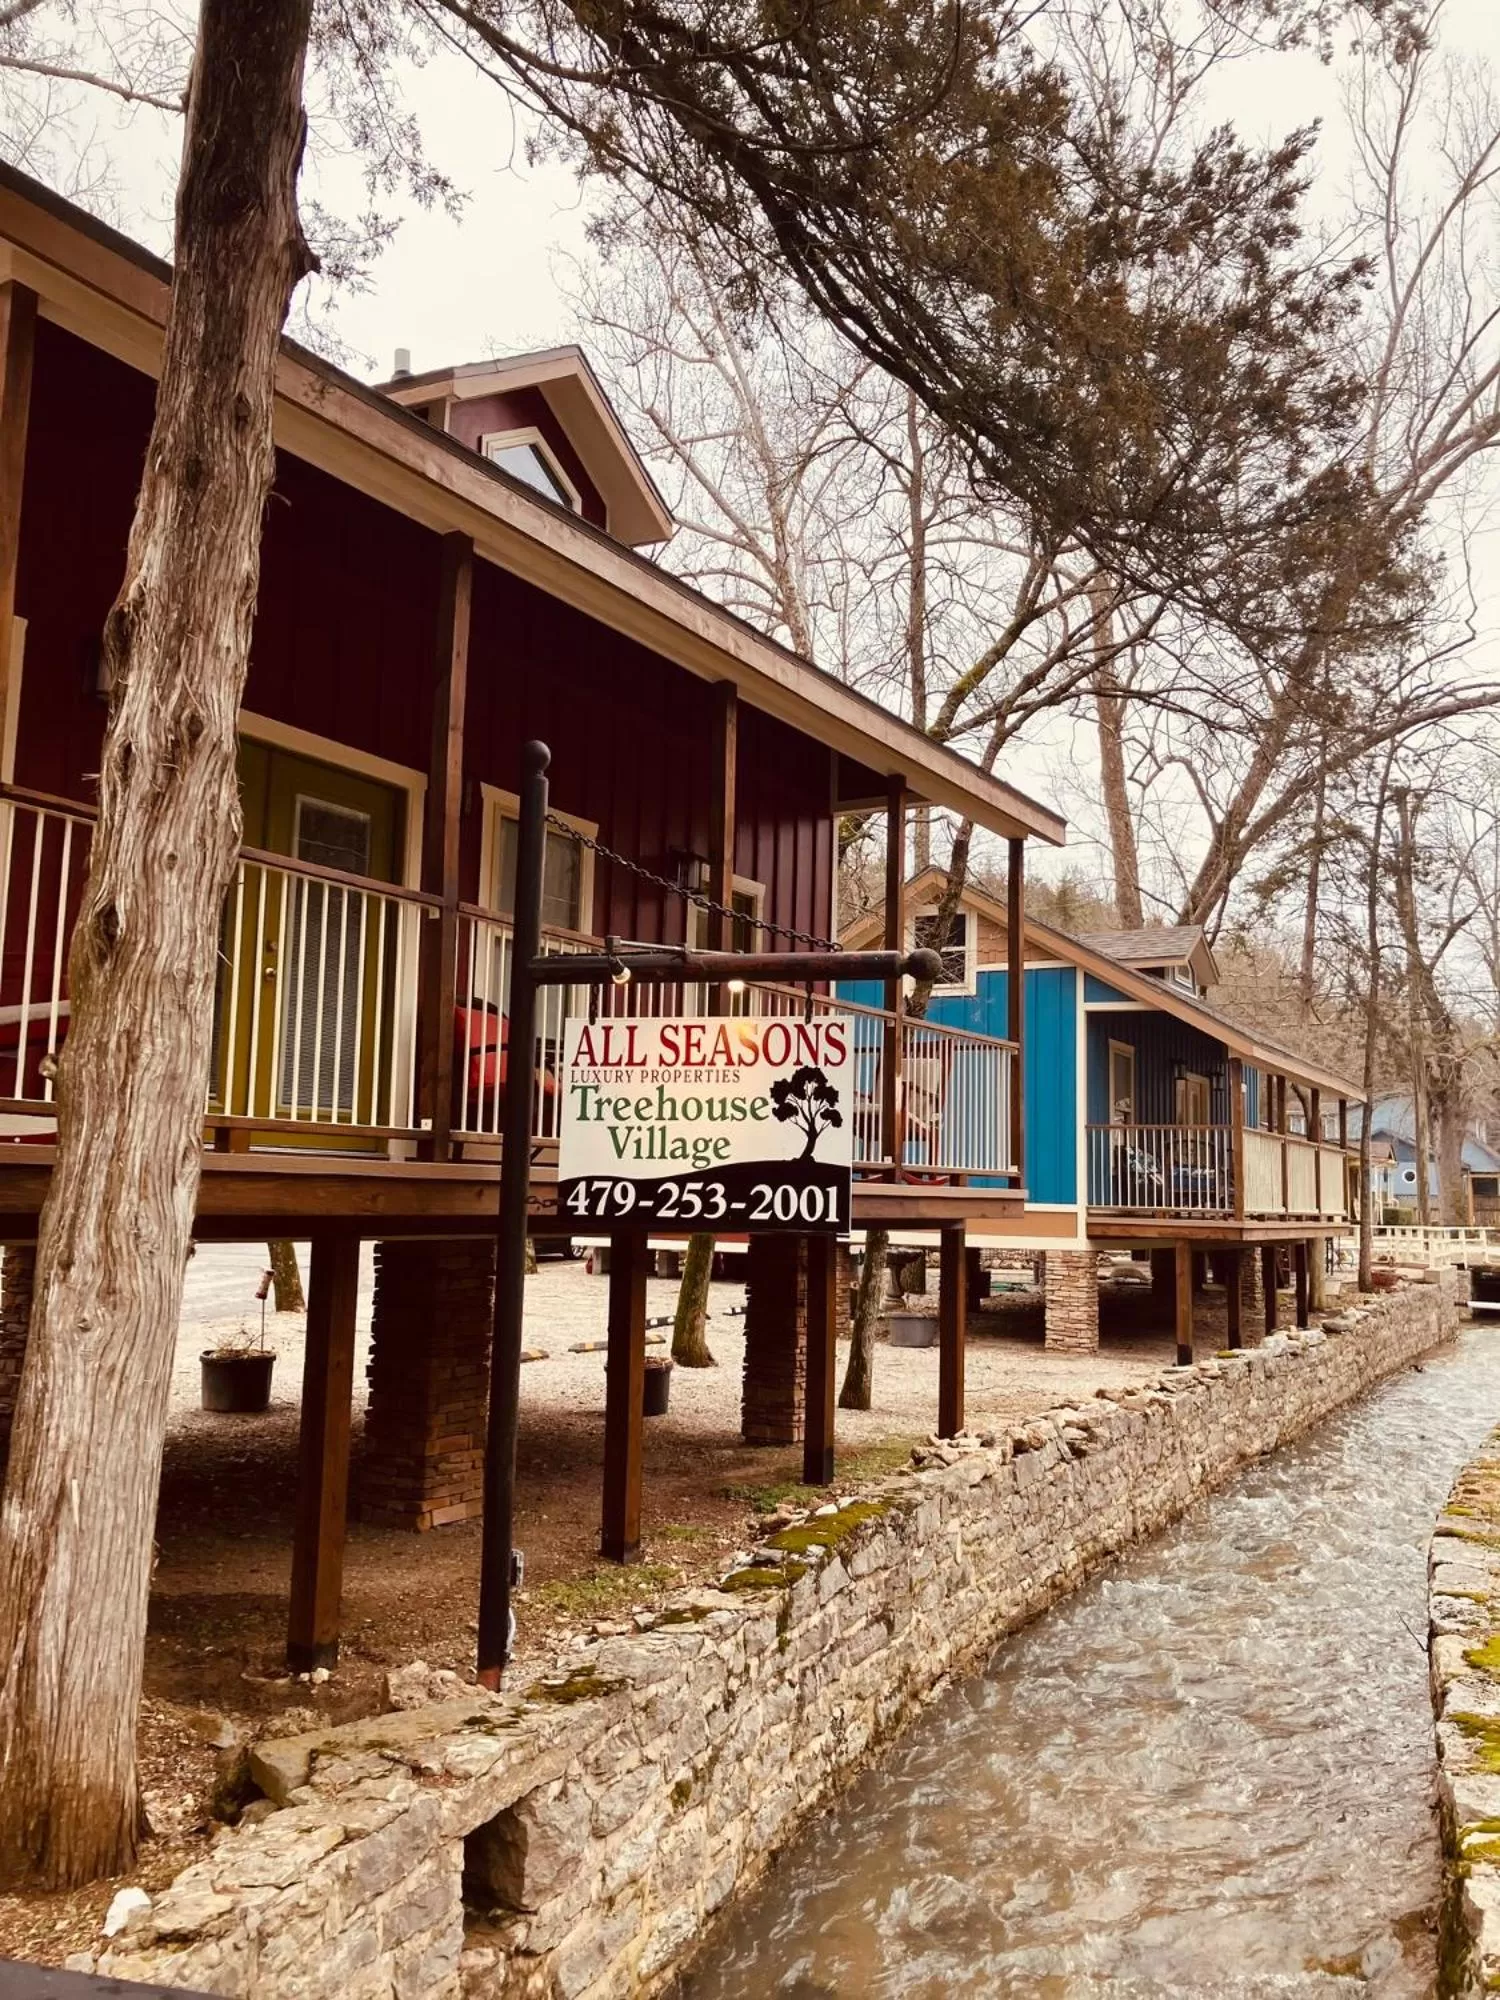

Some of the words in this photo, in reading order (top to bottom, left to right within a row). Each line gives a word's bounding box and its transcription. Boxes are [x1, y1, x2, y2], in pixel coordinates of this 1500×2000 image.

[571, 1024, 648, 1067] ALL
[658, 1022, 847, 1067] SEASONS
[571, 1069, 633, 1084] LUXURY
[640, 1069, 740, 1083] PROPERTIES
[570, 1084, 769, 1122] Treehouse
[607, 1124, 731, 1169] Village
[566, 1180, 840, 1223] 479-253-2001
